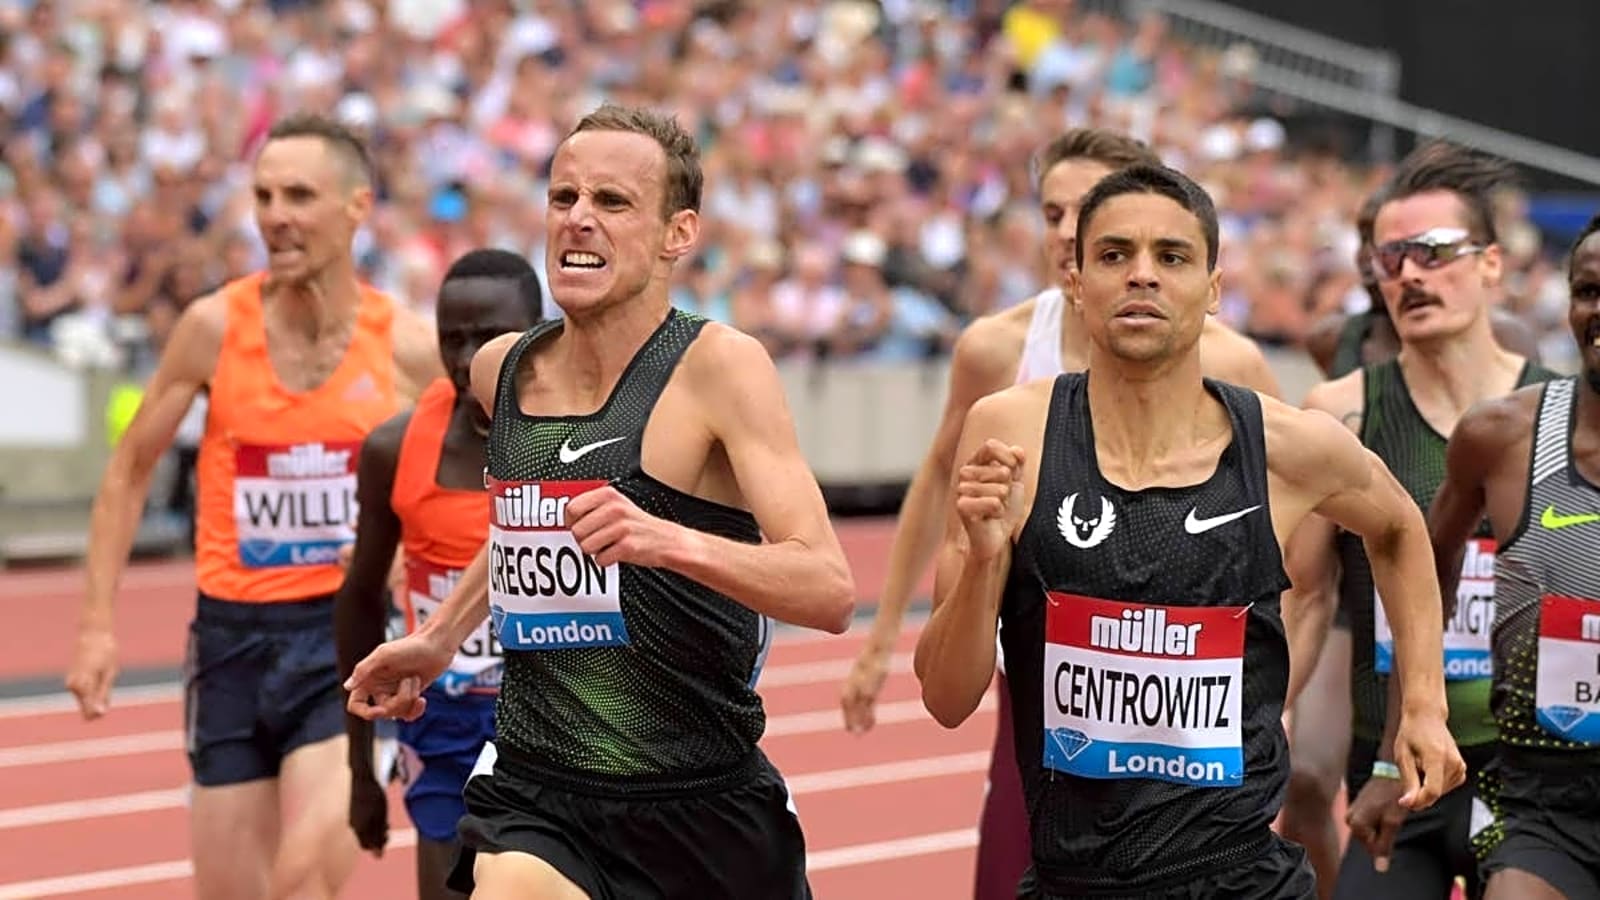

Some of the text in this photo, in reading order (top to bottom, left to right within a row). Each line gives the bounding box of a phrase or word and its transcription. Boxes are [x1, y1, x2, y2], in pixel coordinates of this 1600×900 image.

[243, 488, 360, 528] WILLI
[490, 541, 608, 597] GREGSON
[516, 620, 613, 645] London
[1090, 608, 1202, 656] müller
[1054, 661, 1232, 729] CENTROWITZ
[1108, 750, 1225, 781] London
